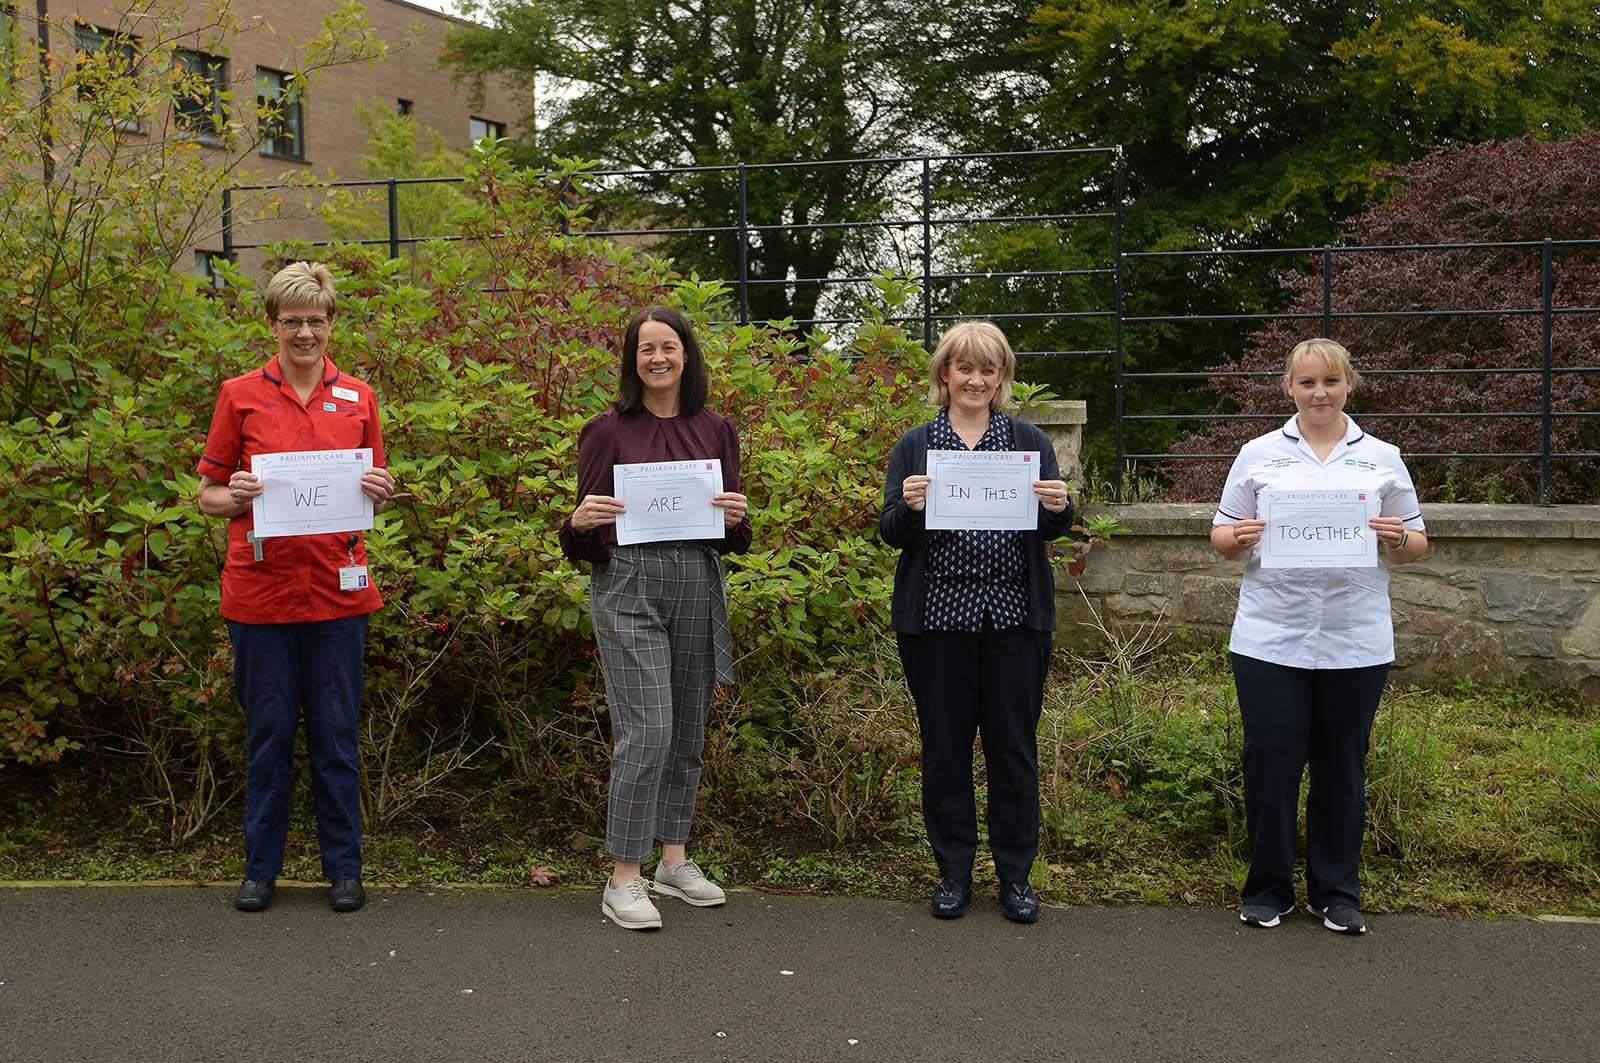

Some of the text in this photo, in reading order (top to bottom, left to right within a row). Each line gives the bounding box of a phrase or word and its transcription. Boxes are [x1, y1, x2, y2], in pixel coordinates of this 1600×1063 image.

[640, 465, 677, 473] PALLIATIVE
[293, 485, 329, 508] WE
[946, 484, 1018, 502] IN THIS
[646, 496, 683, 513] ARE
[1277, 525, 1365, 541] TOGETHER
